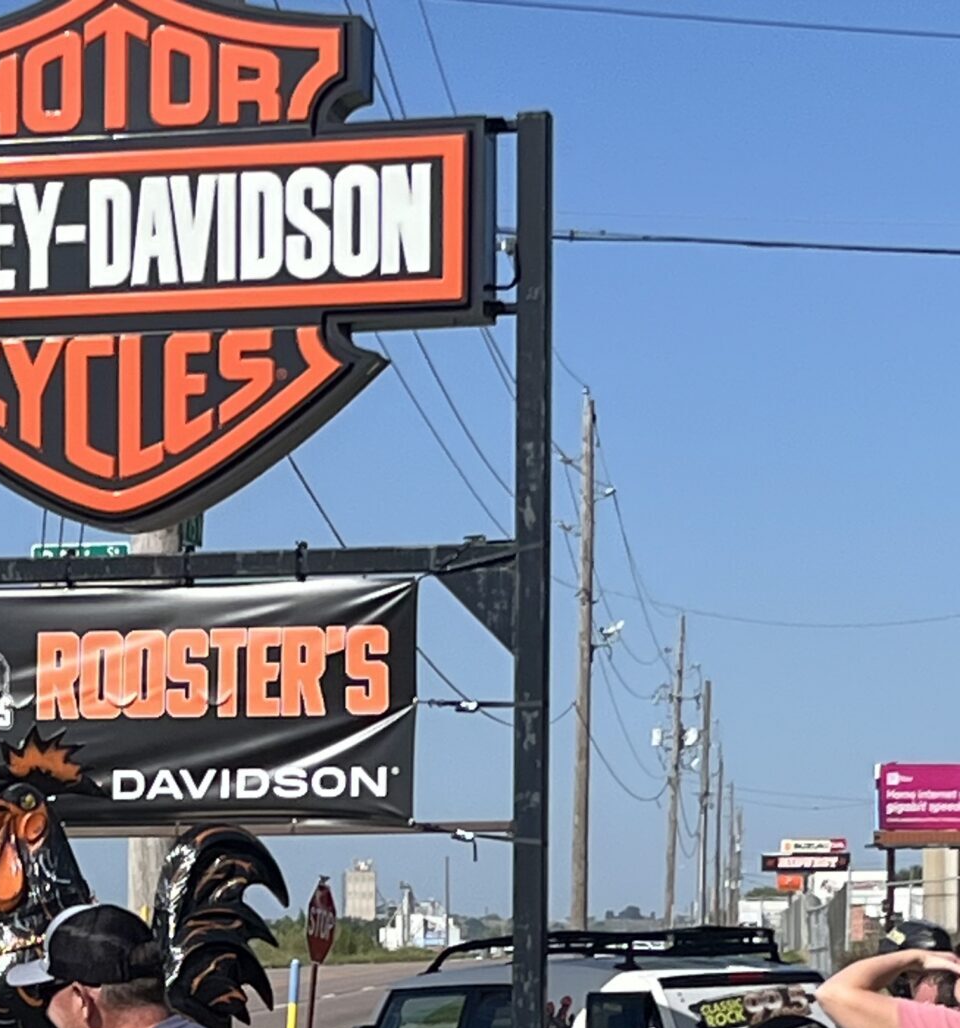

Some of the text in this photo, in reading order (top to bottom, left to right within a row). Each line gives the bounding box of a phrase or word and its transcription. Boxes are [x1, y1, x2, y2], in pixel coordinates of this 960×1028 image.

[35, 624, 390, 721] ROOSTER'S
[309, 906, 335, 940] STOP
[700, 998, 743, 1016] CLASSIC
[706, 1009, 746, 1028] ROCK
